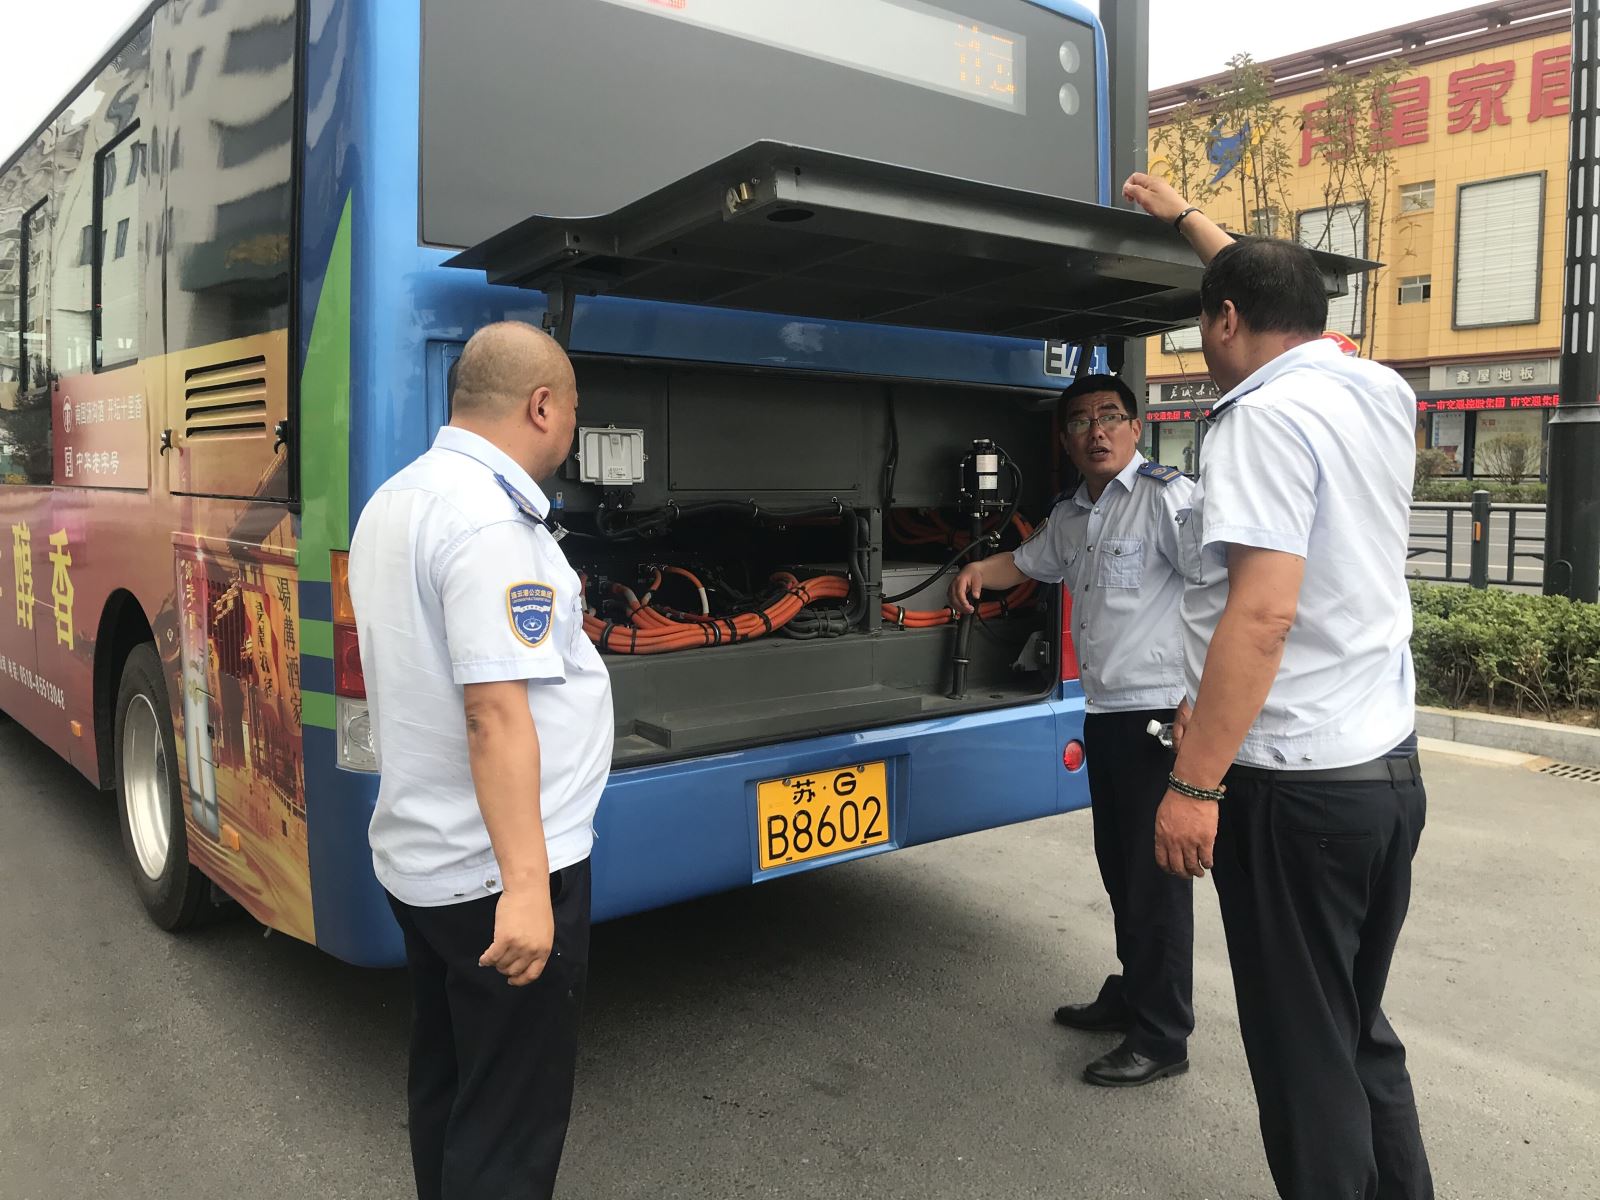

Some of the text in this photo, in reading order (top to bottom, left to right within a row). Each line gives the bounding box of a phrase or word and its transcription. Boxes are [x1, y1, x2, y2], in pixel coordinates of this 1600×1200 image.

[1456, 367, 1535, 384] 鑫屋地板
[76, 451, 120, 475] 中华老字号
[767, 796, 883, 861] B8602
